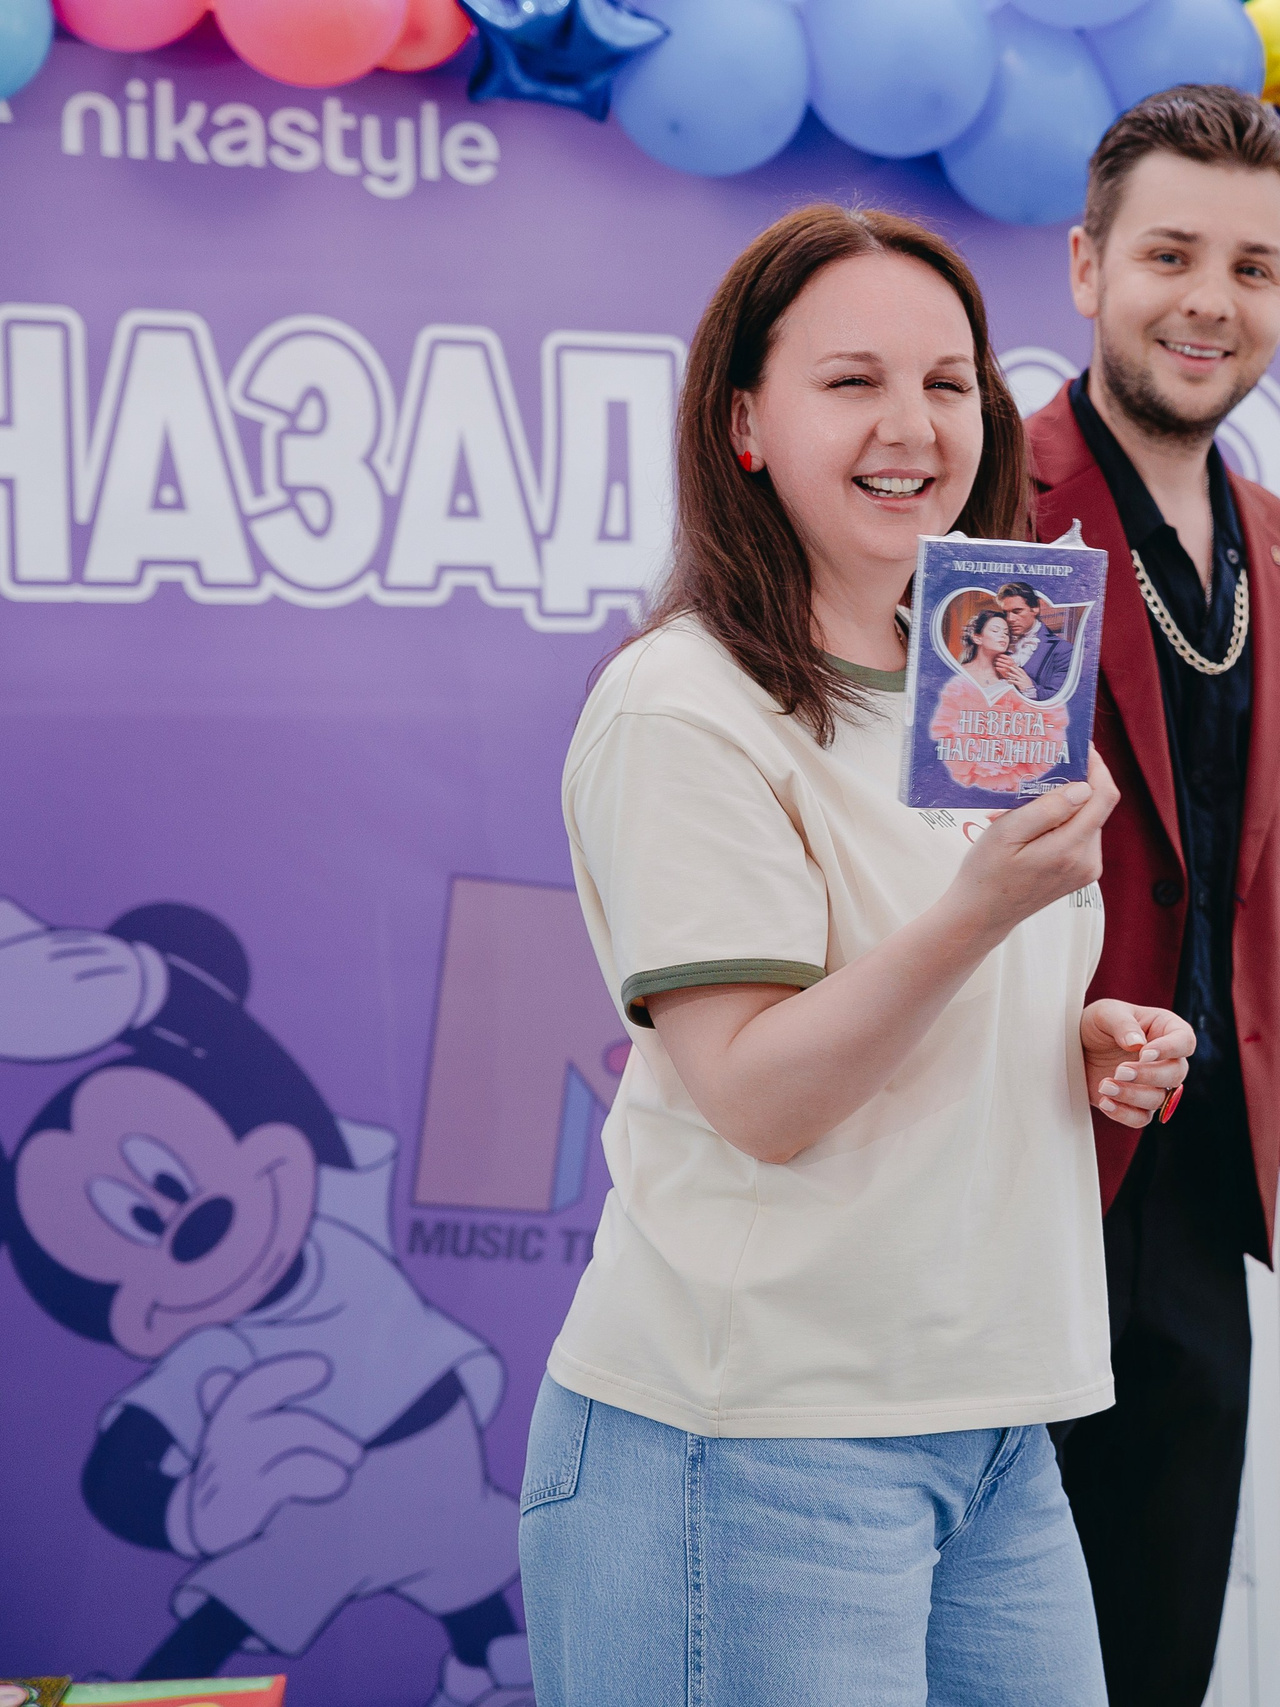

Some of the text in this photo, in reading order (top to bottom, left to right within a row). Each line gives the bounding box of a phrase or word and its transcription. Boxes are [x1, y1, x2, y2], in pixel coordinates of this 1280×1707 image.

[61, 78, 501, 199] nikastyle
[952, 560, 1073, 577] МЭДЛИН ХАНТЕР
[958, 709, 1055, 736] НЕВЕСТА-
[935, 737, 1070, 767] НАСЛЕДНИЦА
[407, 1218, 545, 1263] MUSIC
